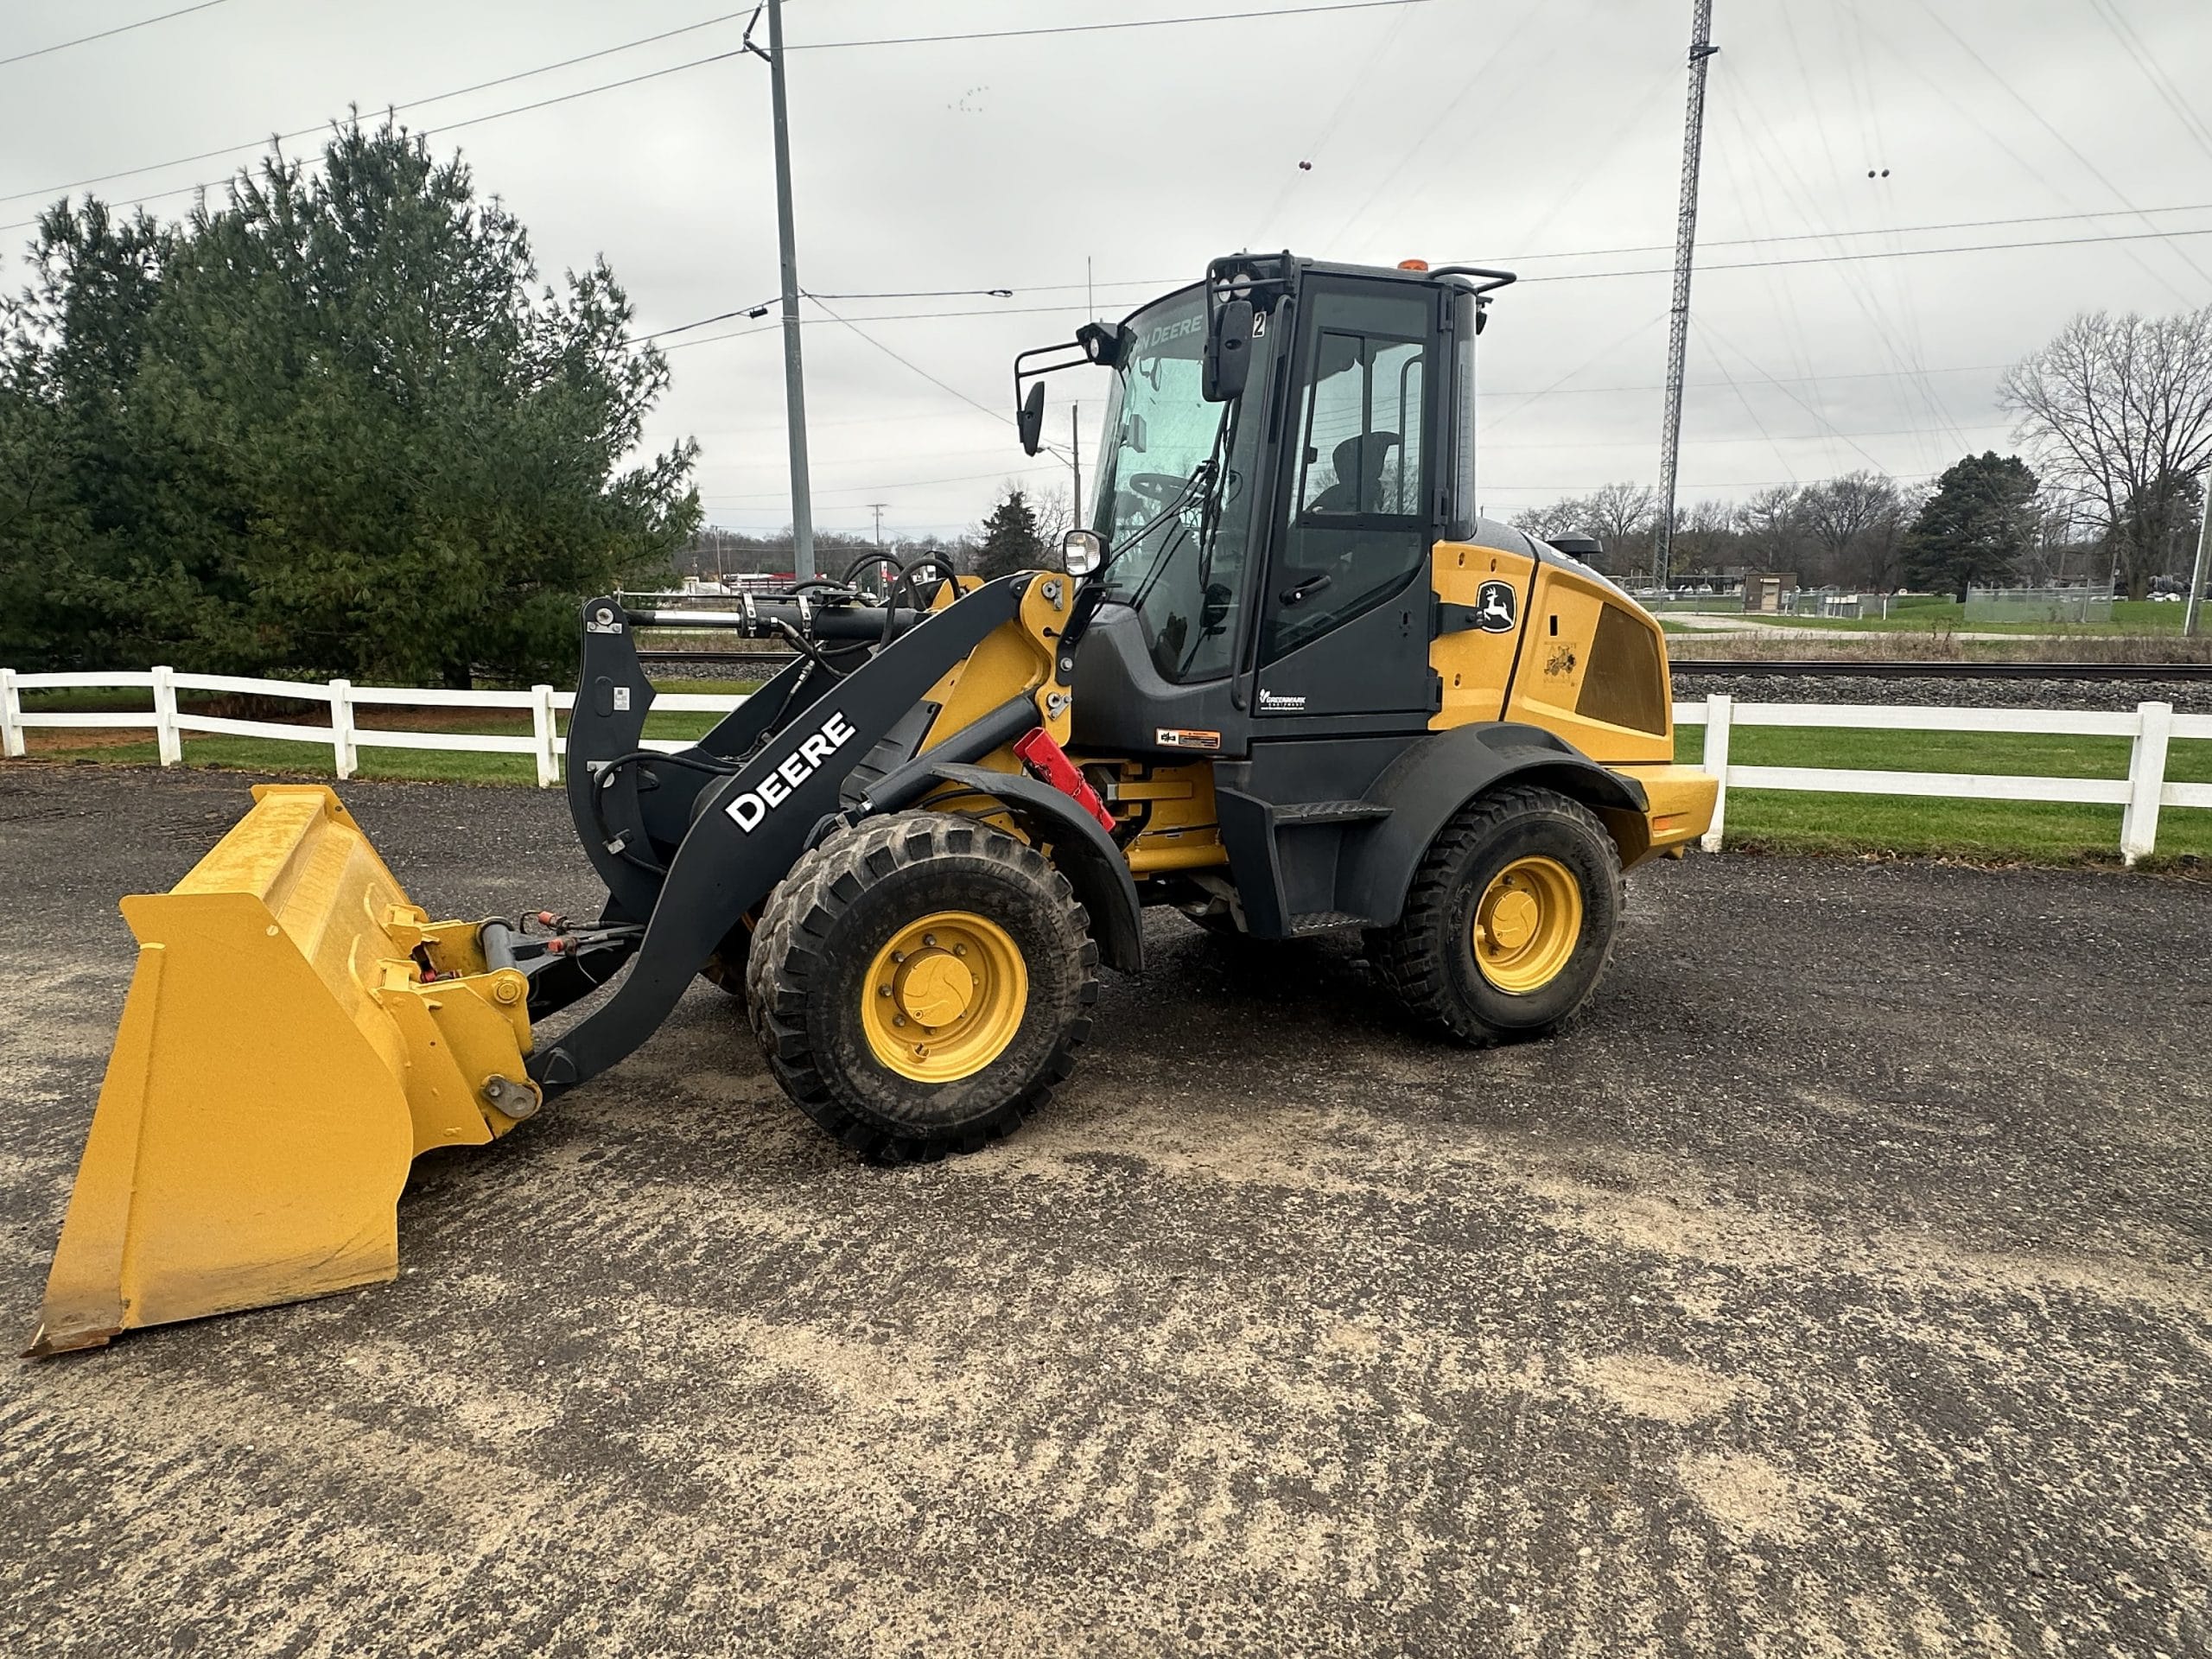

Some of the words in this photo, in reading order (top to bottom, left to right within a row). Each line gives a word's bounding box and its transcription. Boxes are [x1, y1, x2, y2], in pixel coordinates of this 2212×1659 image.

[1151, 314, 1204, 346] DEERE
[1254, 313, 1265, 336] 2
[724, 711, 856, 833] DEERE
